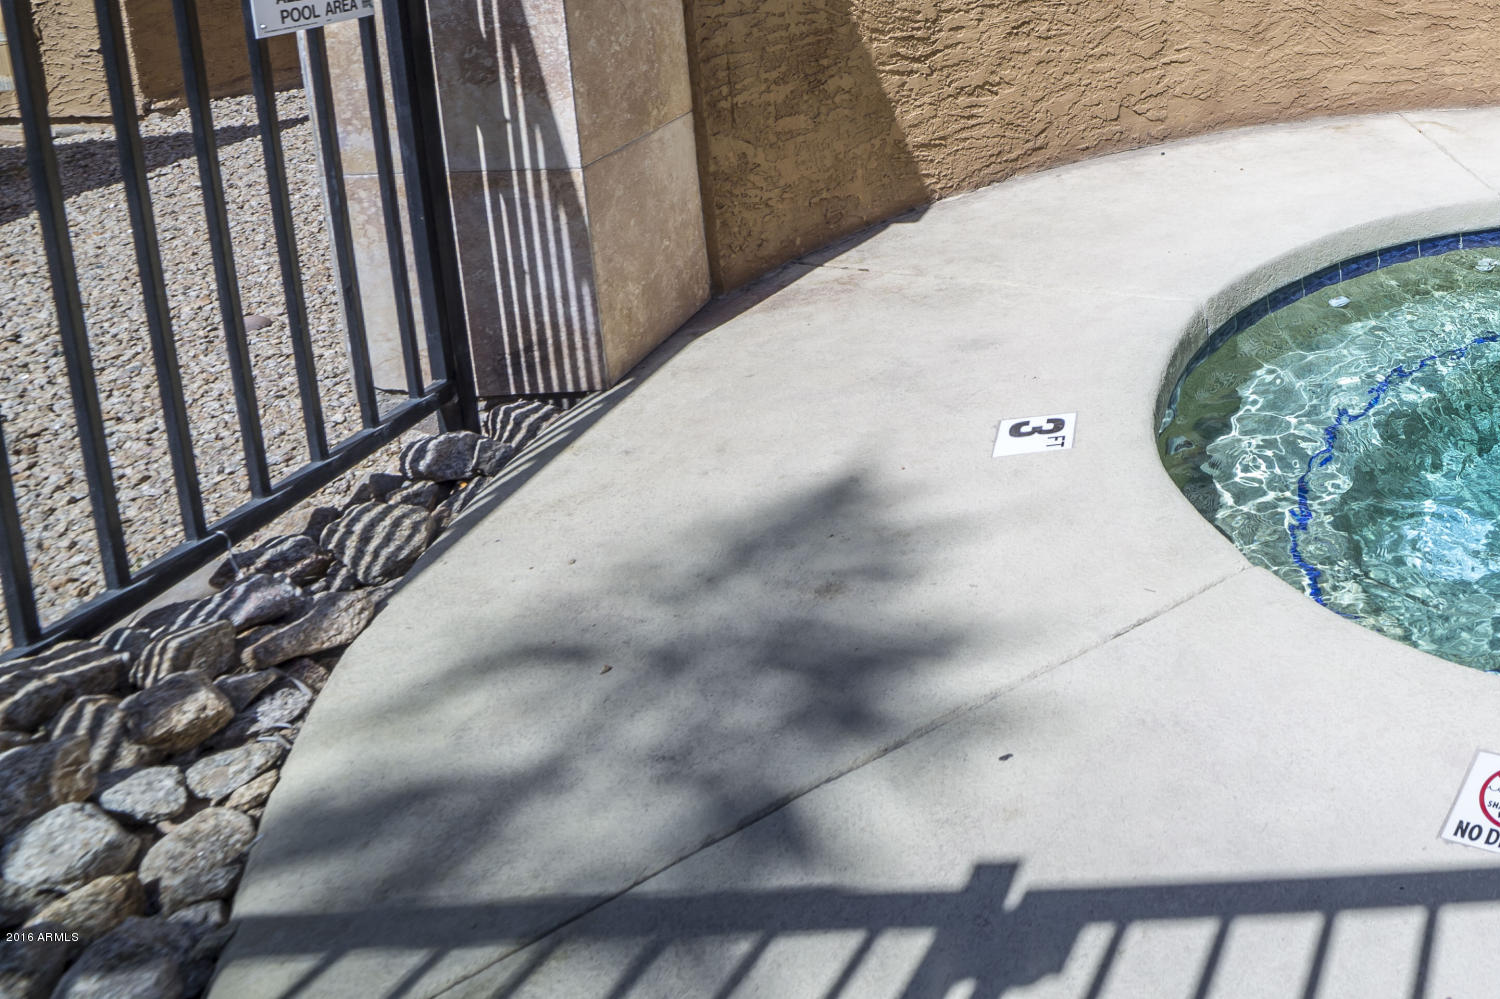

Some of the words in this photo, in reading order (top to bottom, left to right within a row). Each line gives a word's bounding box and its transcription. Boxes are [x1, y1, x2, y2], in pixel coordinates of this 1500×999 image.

[280, 4, 320, 24] POOL
[1009, 418, 1065, 438] 3
[1453, 819, 1483, 841] NO
